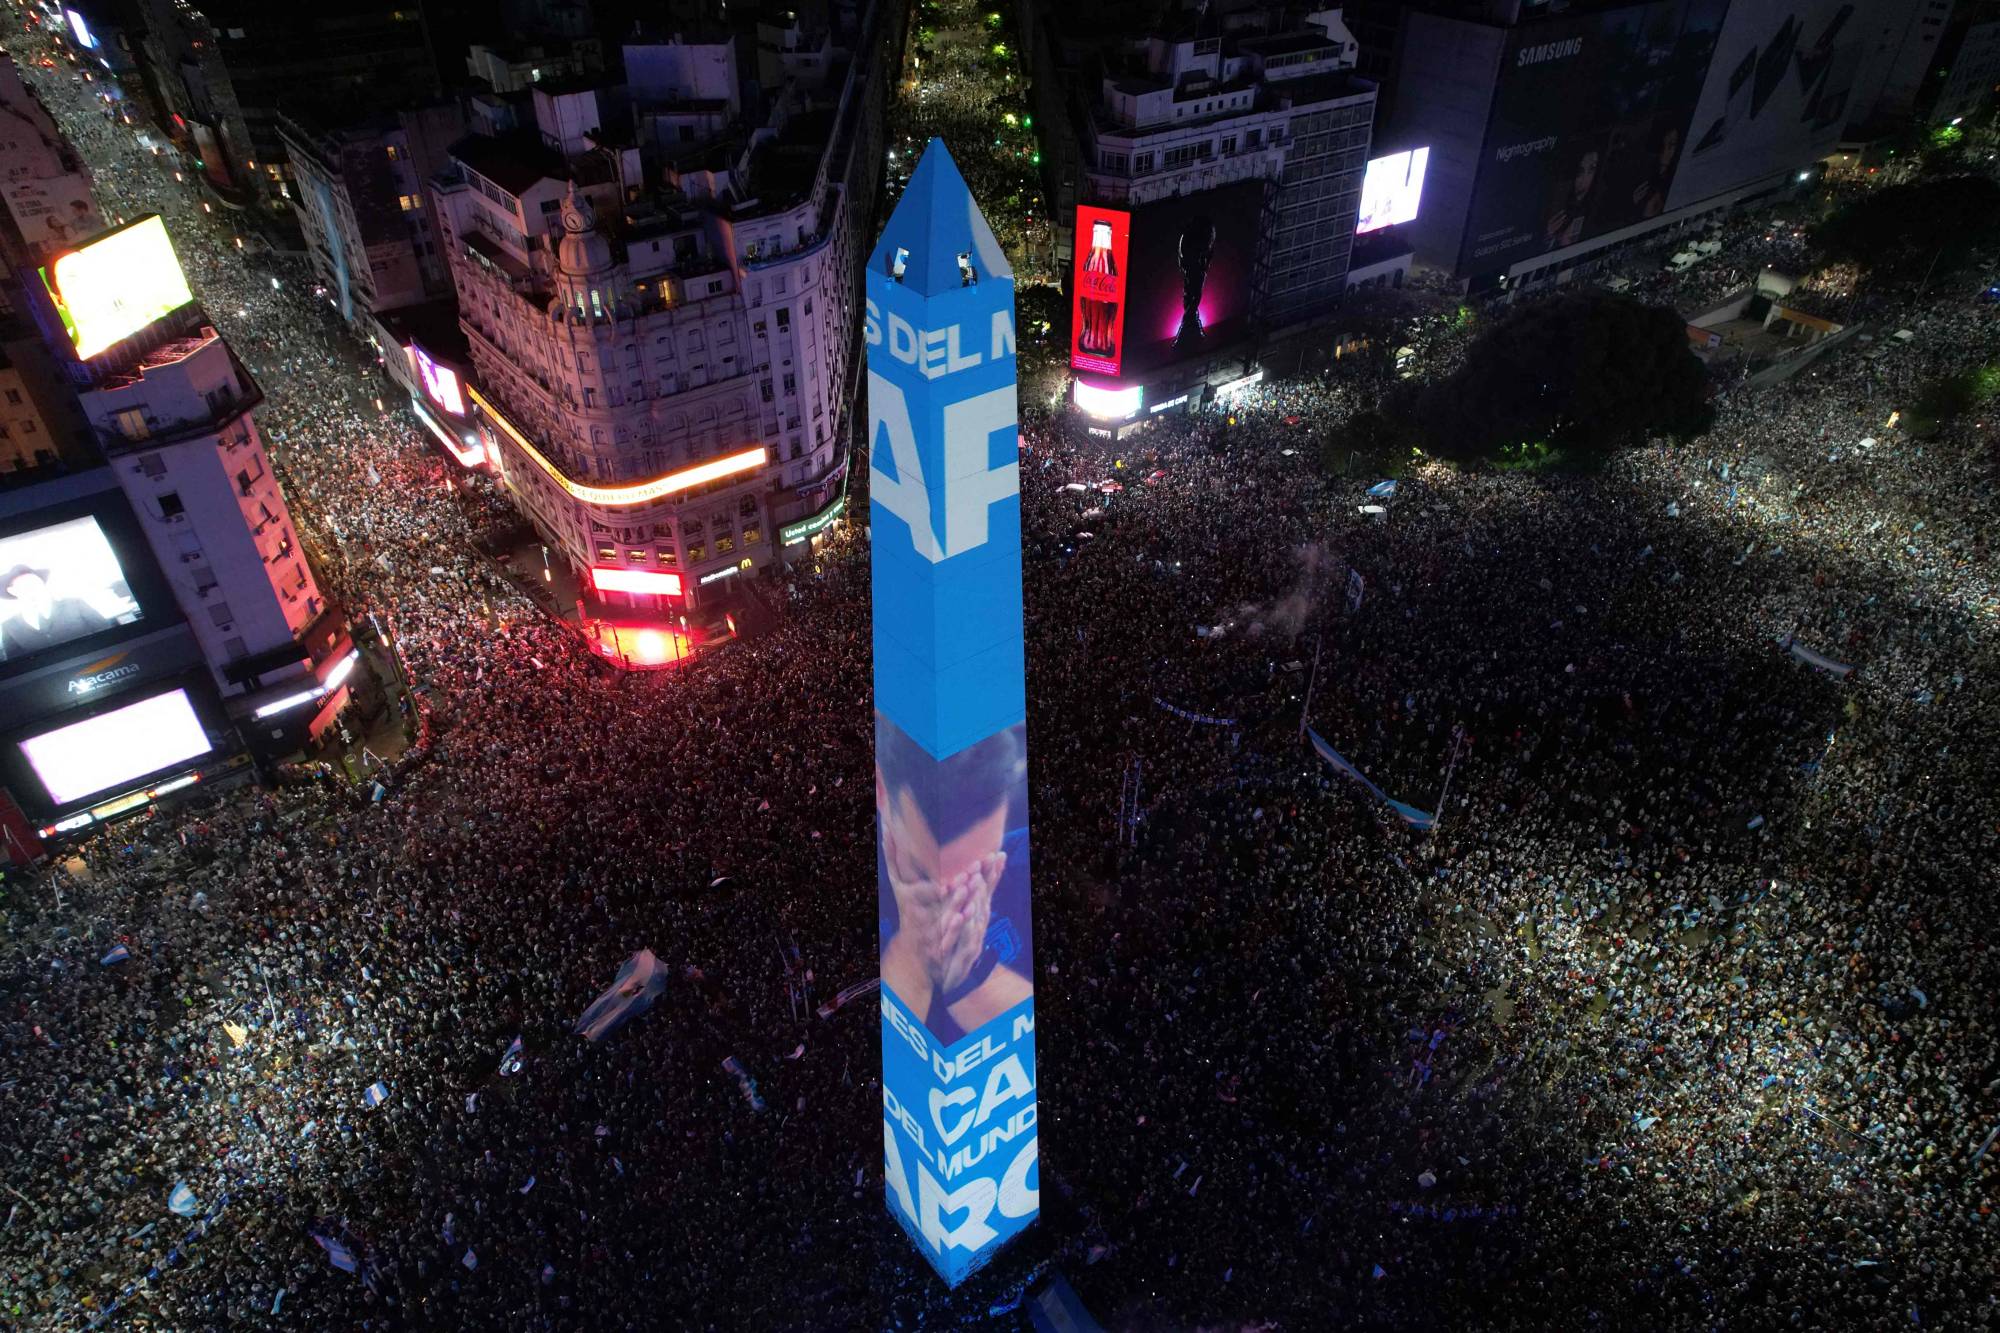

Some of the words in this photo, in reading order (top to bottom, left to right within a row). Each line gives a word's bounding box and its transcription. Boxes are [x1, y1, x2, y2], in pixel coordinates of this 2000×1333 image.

[1517, 36, 1582, 67] SAMSUNG
[1496, 135, 1558, 162] Nightography
[888, 311, 981, 380] DEL
[67, 662, 140, 692] Atacama
[933, 1041, 1006, 1085] DEL
[883, 1084, 935, 1163] DEL
